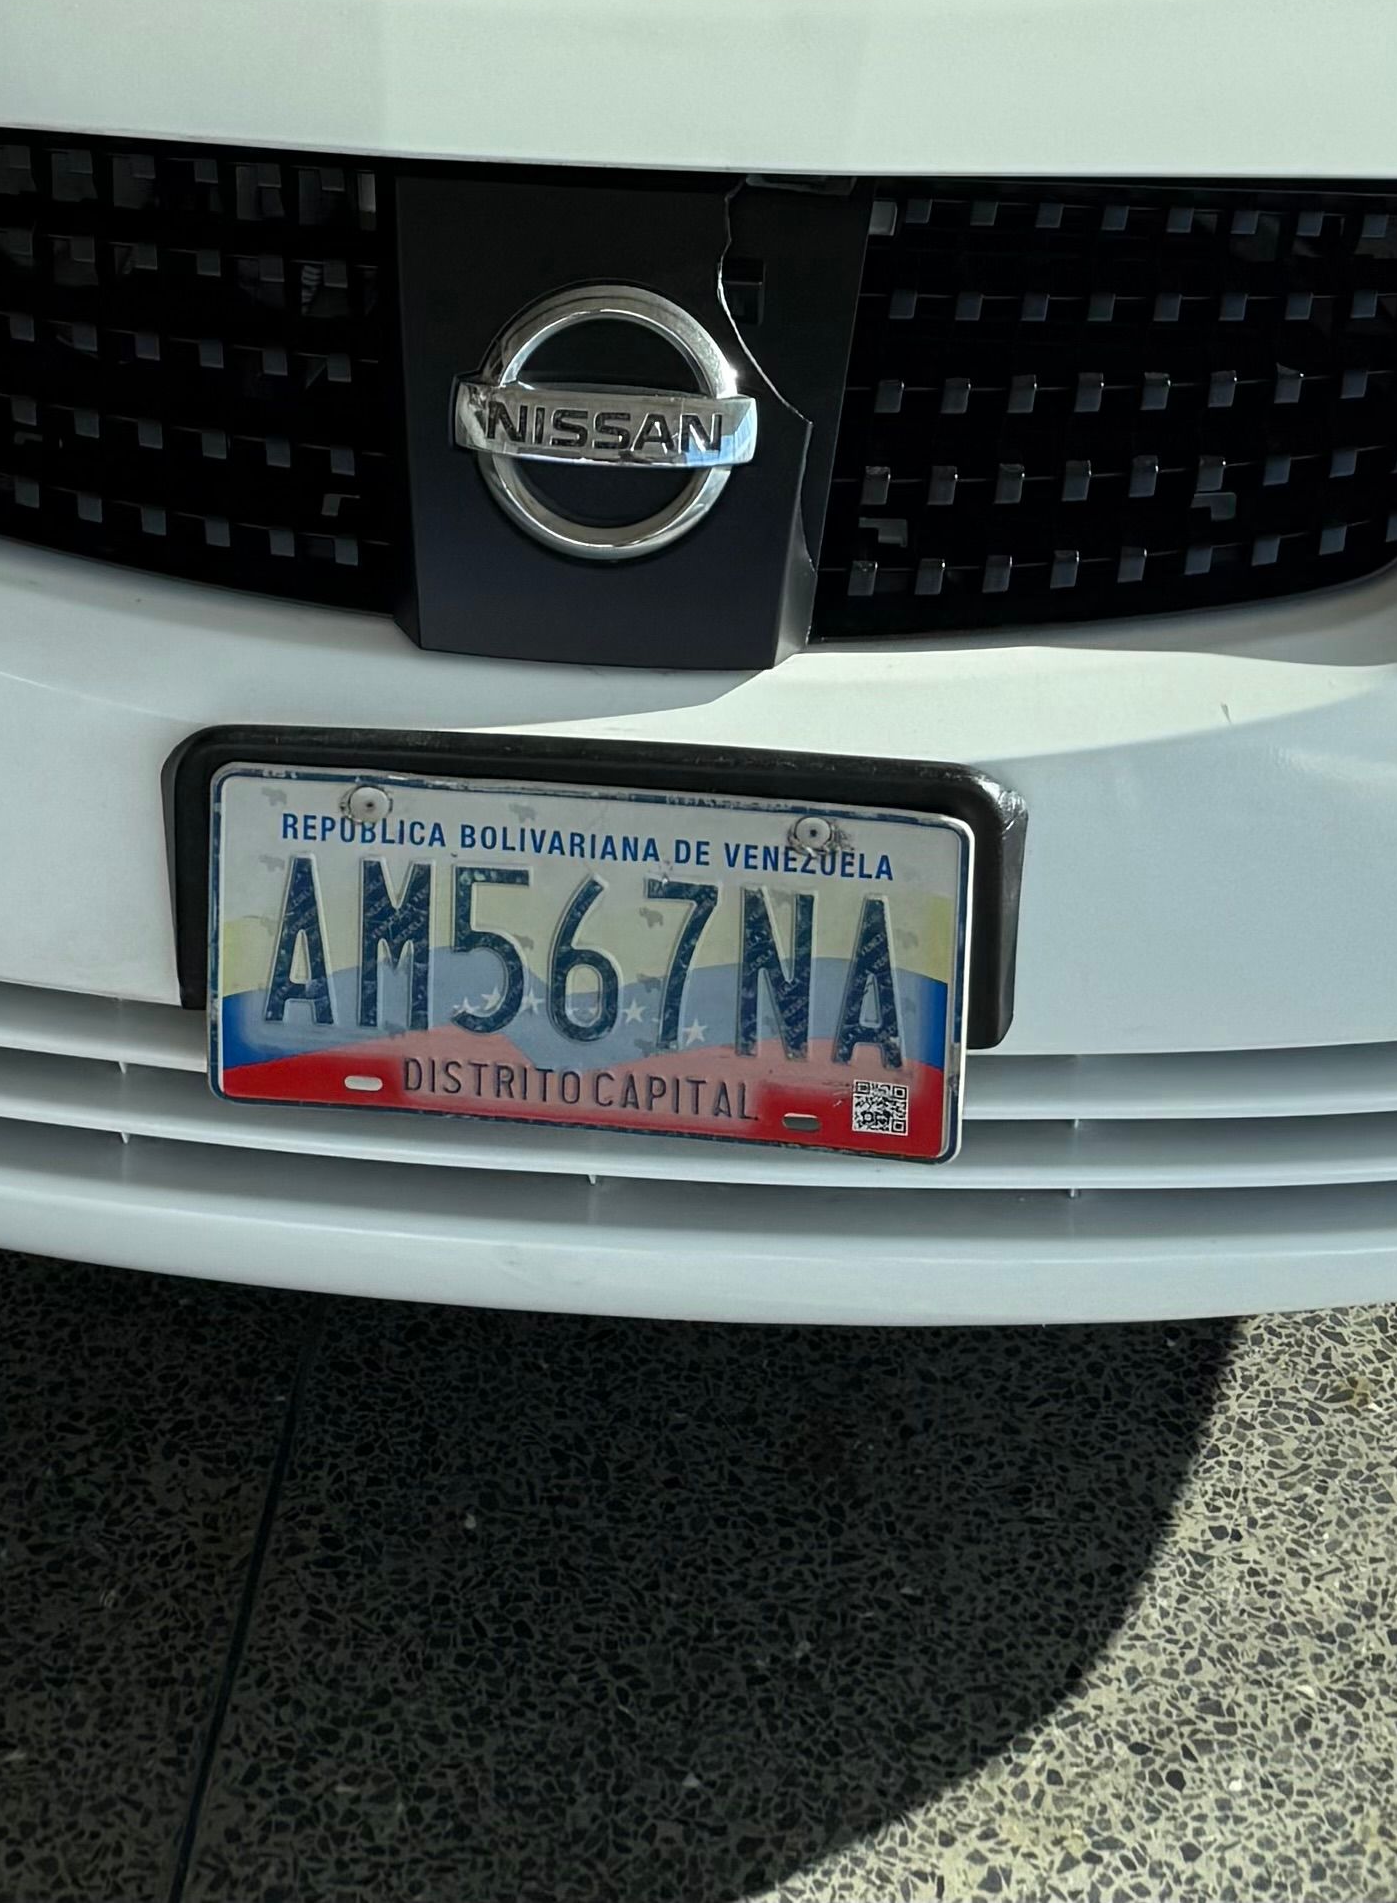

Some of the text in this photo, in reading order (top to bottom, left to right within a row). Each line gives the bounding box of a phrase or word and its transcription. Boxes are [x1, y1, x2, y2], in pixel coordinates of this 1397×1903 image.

[486, 400, 724, 454] NISSAN
[459, 823, 660, 863] BOLIVARIANA
[673, 839, 711, 868] DE
[723, 842, 894, 882] VENEZUELA
[262, 855, 906, 1072] AM567NA
[403, 1055, 760, 1121] DISTRITO CAPITAL
